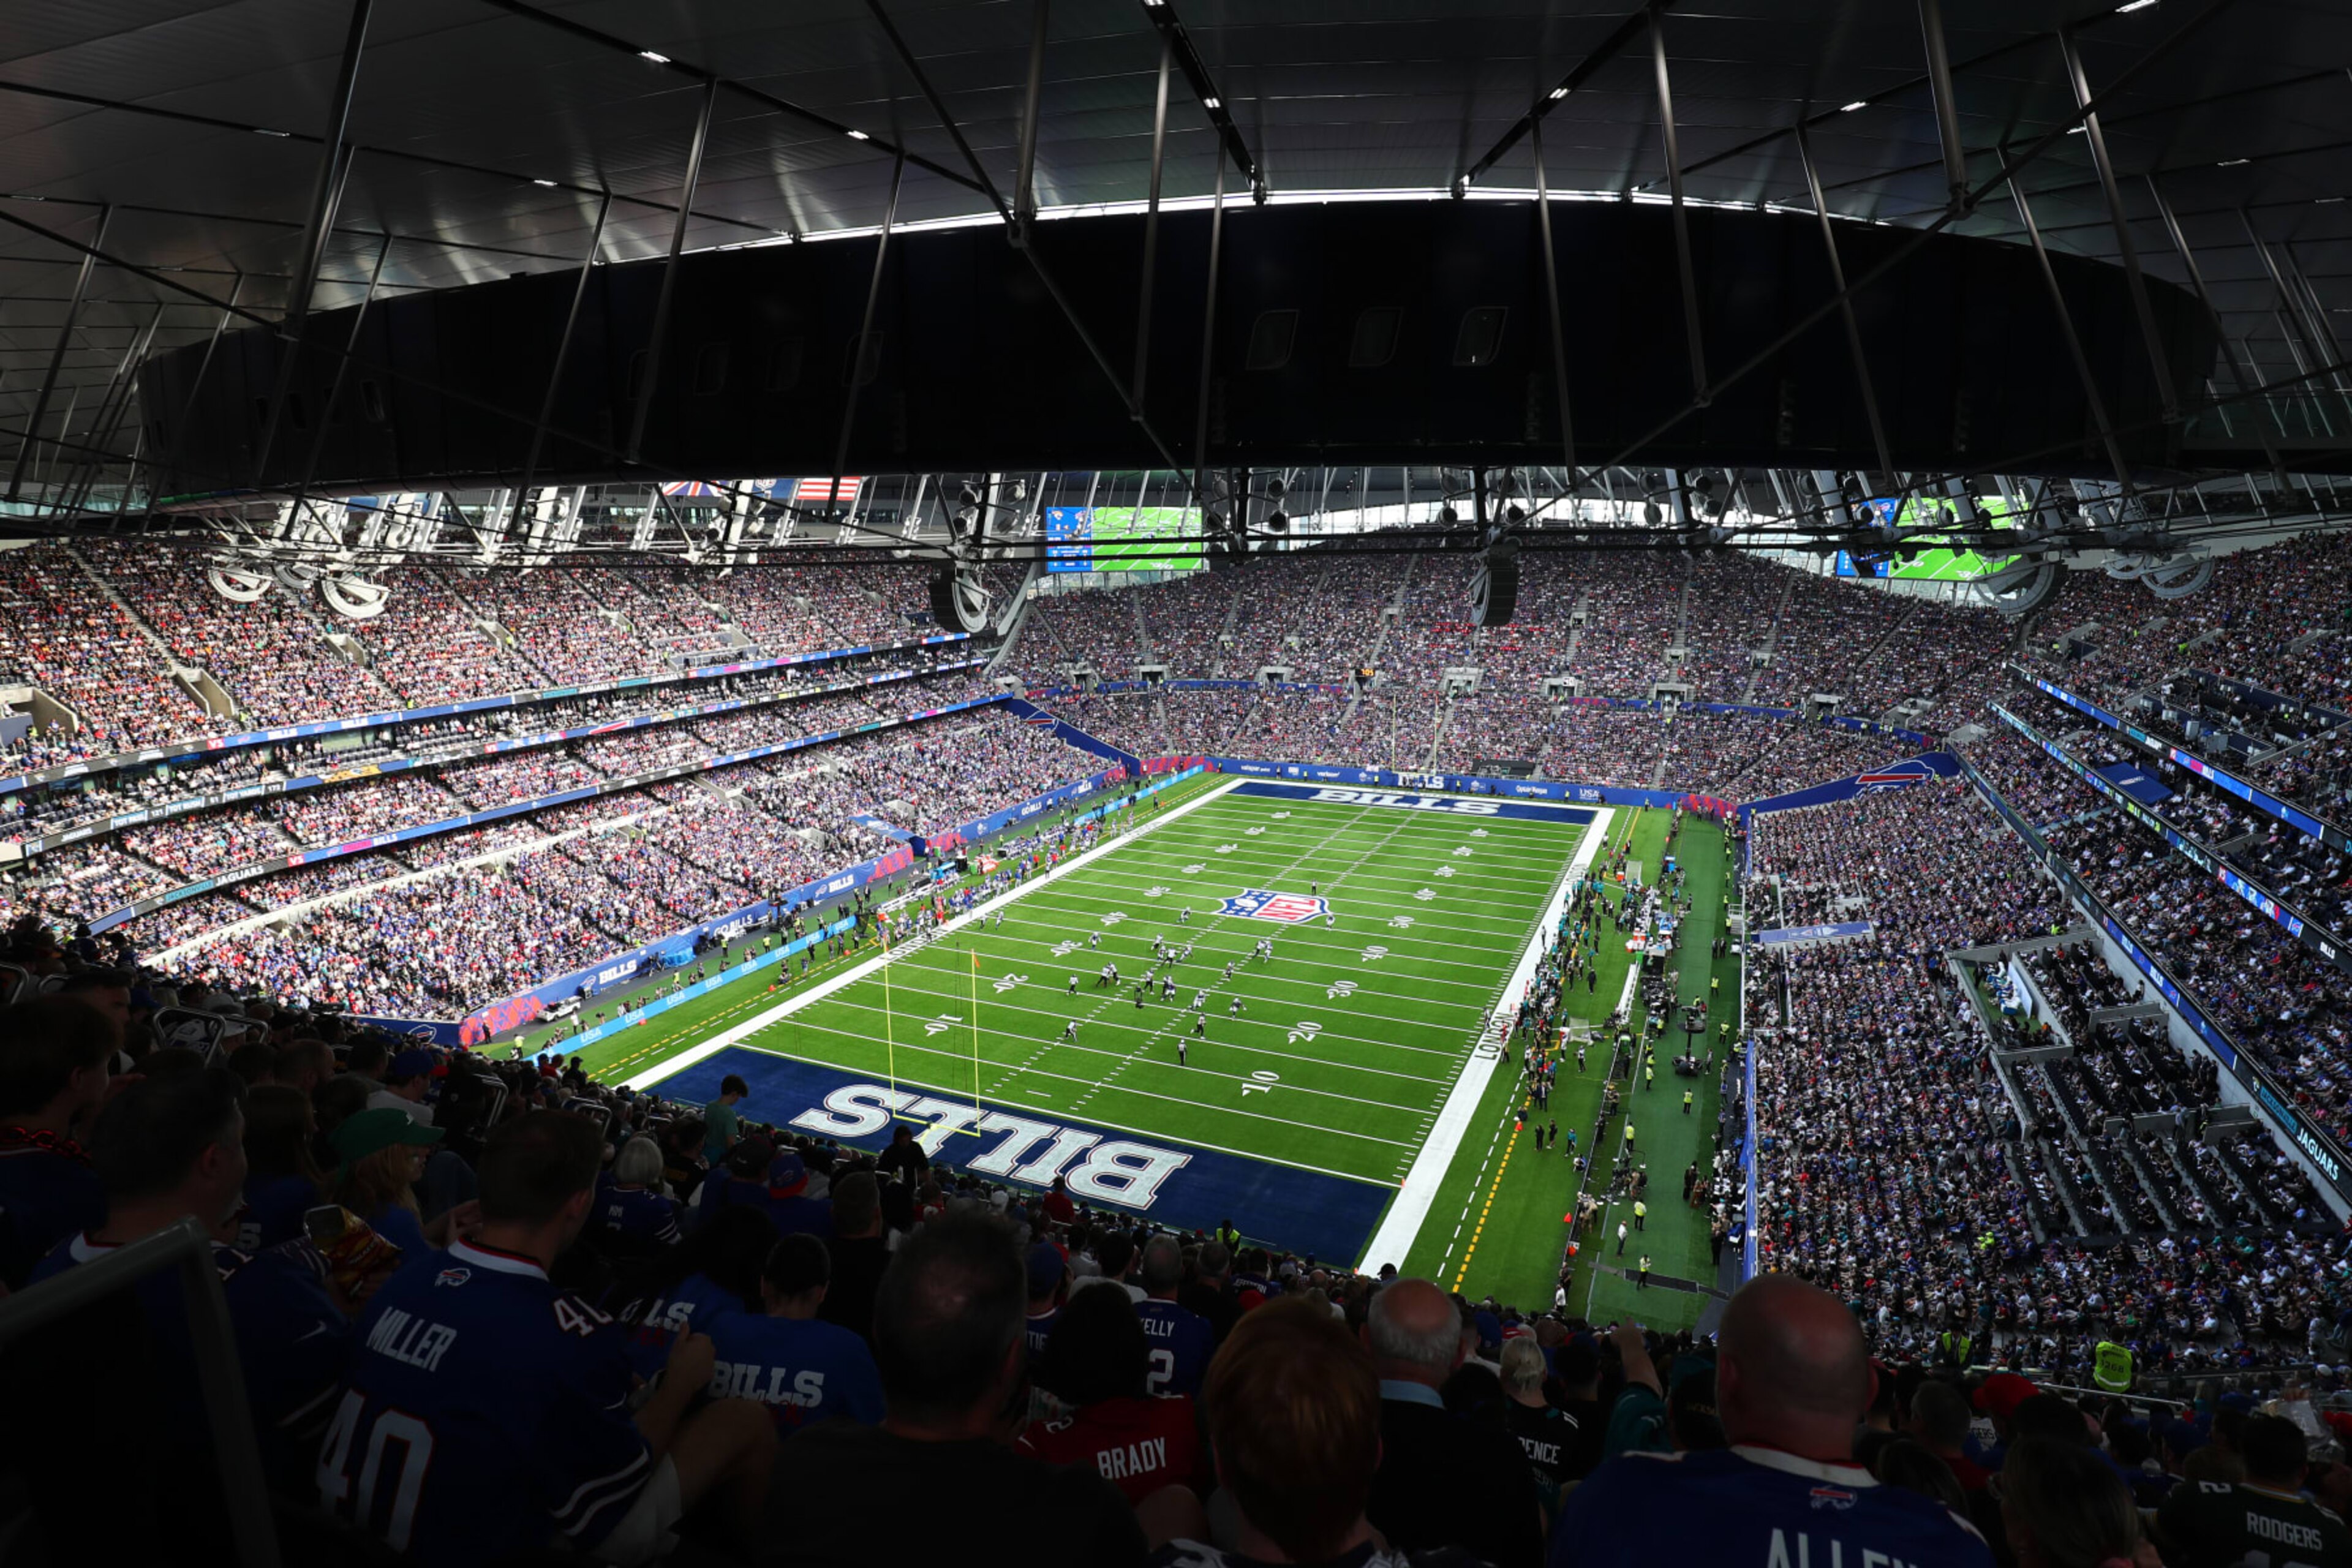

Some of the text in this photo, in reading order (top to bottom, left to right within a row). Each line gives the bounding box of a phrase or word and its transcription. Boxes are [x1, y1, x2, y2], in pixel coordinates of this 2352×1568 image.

[208, 739, 223, 749] VS
[1310, 788, 1501, 815] BILLS
[1579, 788, 1600, 797] USA
[289, 833, 398, 865] VS BILLS
[216, 865, 264, 887] JAGUARS
[829, 874, 854, 893] BILLS
[1261, 895, 1317, 922] NFL
[713, 914, 753, 938] GO BILLS
[1389, 916, 1414, 929] 50
[775, 945, 790, 959] USA
[1362, 945, 1389, 961] 40
[2320, 941, 2335, 960] BILLS
[598, 959, 638, 985] BILLS
[741, 959, 758, 974] USA
[2149, 965, 2164, 987] BILLS
[705, 974, 723, 990] USA
[993, 973, 1029, 992] 20
[1328, 980, 1359, 998] 30
[666, 990, 685, 1006] USA
[625, 1009, 646, 1025] USA
[924, 1014, 964, 1034] 10
[580, 1027, 602, 1044] USA
[1289, 1020, 1323, 1042] 20
[1468, 1012, 1515, 1060] LONDON
[1242, 1070, 1280, 1095] 10
[788, 1084, 1194, 1210] BILLS
[2297, 1127, 2340, 1181] JAGUARS
[367, 1306, 458, 1373] MILLER
[709, 1360, 825, 1408] BILLS
[1097, 1436, 1167, 1480] BRADY
[314, 1387, 436, 1556] 40
[2247, 1511, 2323, 1551] RODGERS
